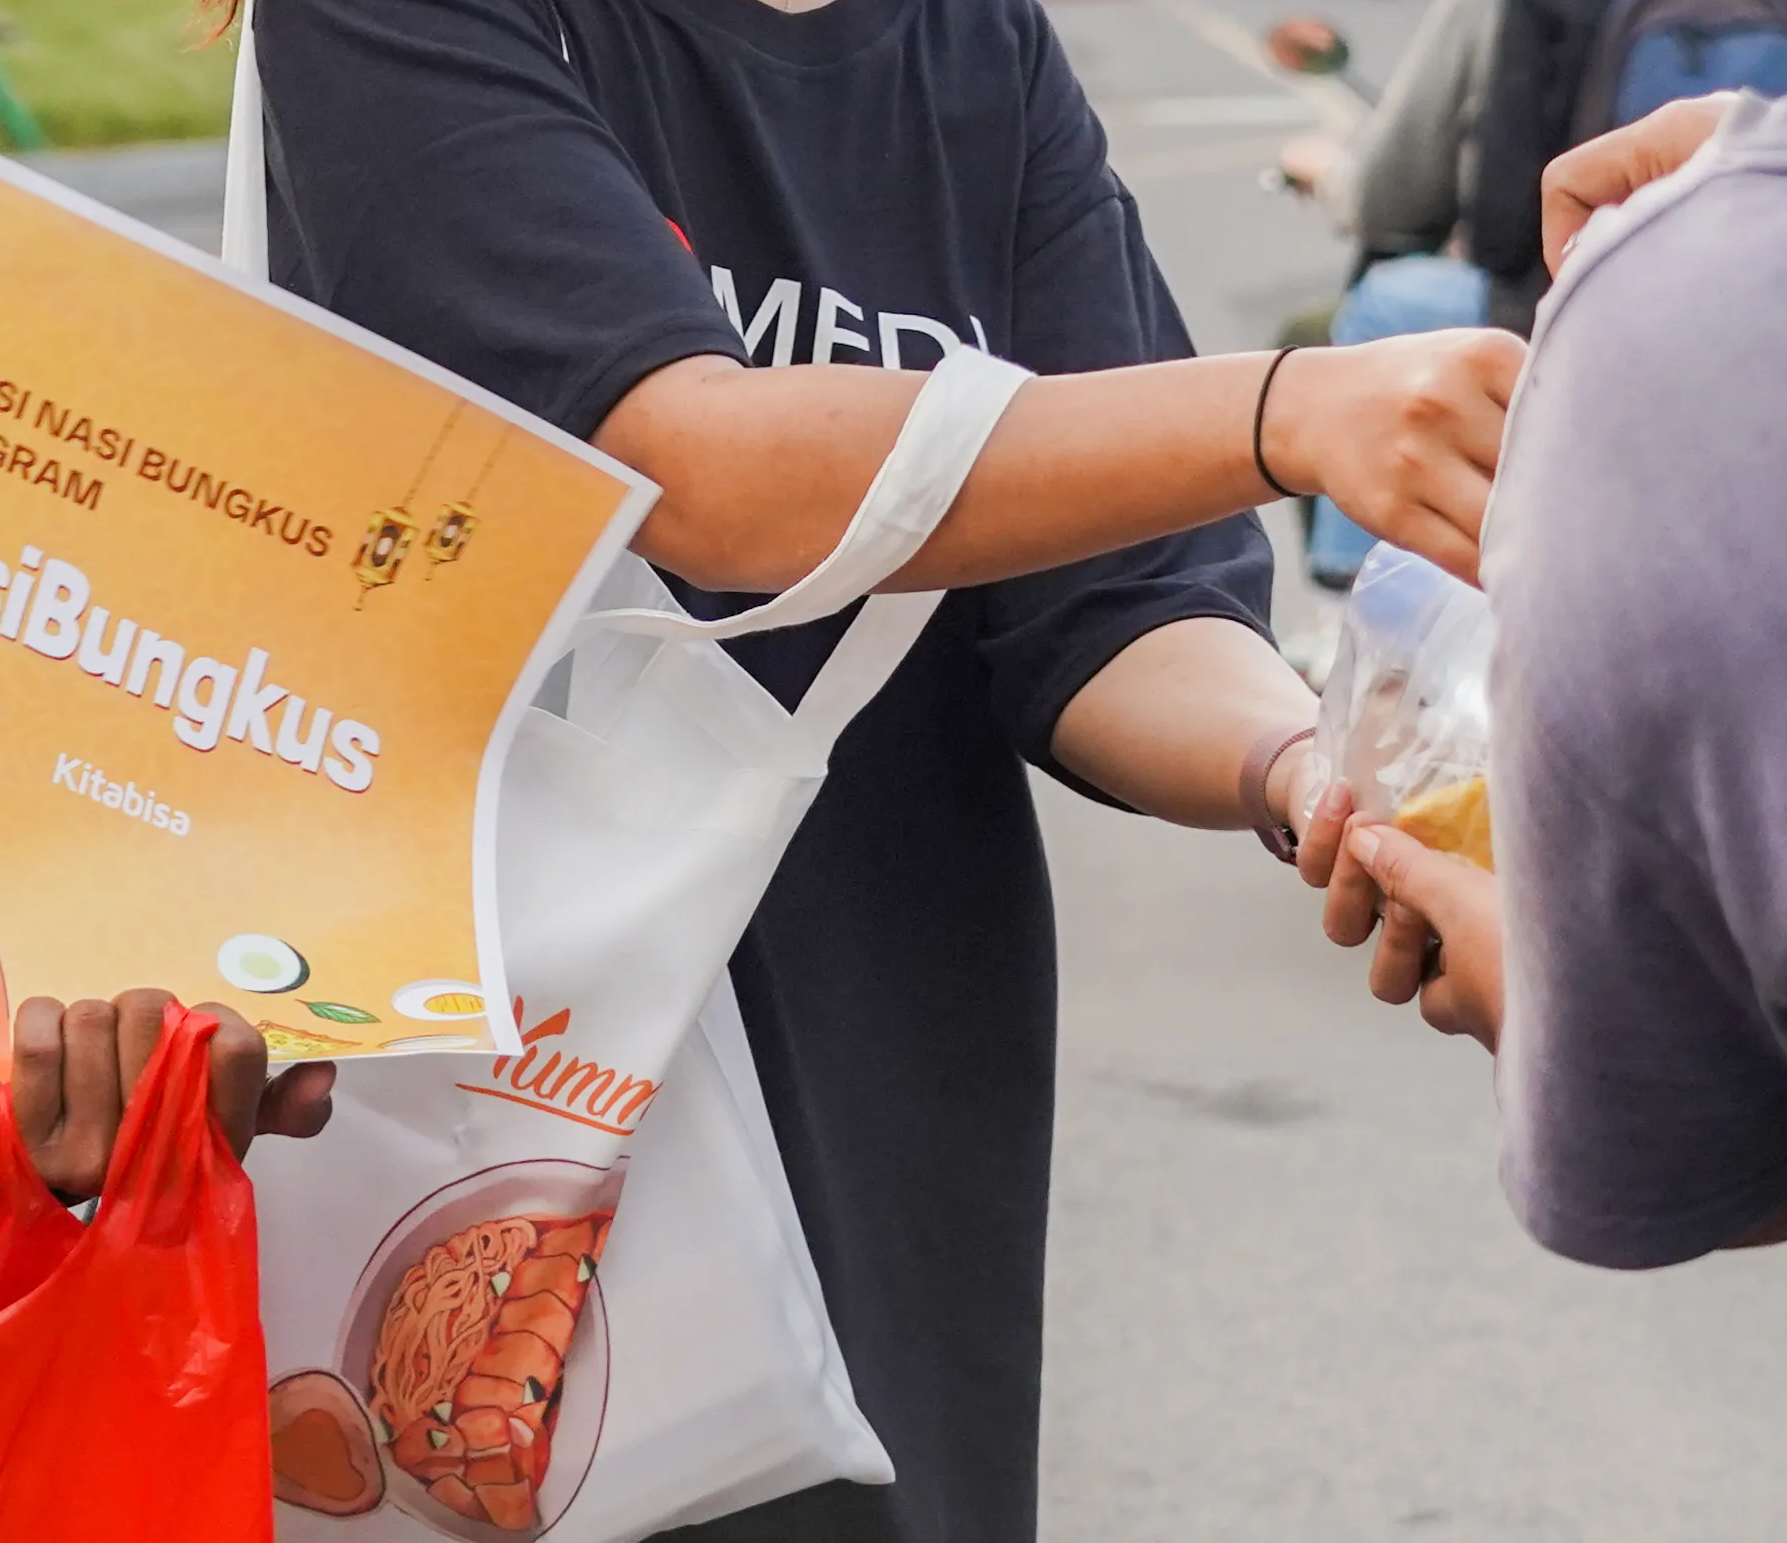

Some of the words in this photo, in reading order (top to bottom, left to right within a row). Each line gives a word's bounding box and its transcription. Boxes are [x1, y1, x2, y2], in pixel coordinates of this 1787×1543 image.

[39, 397, 140, 466] NASI
[139, 446, 335, 560] BUNGKUS
[51, 751, 192, 838] Kitabisa
